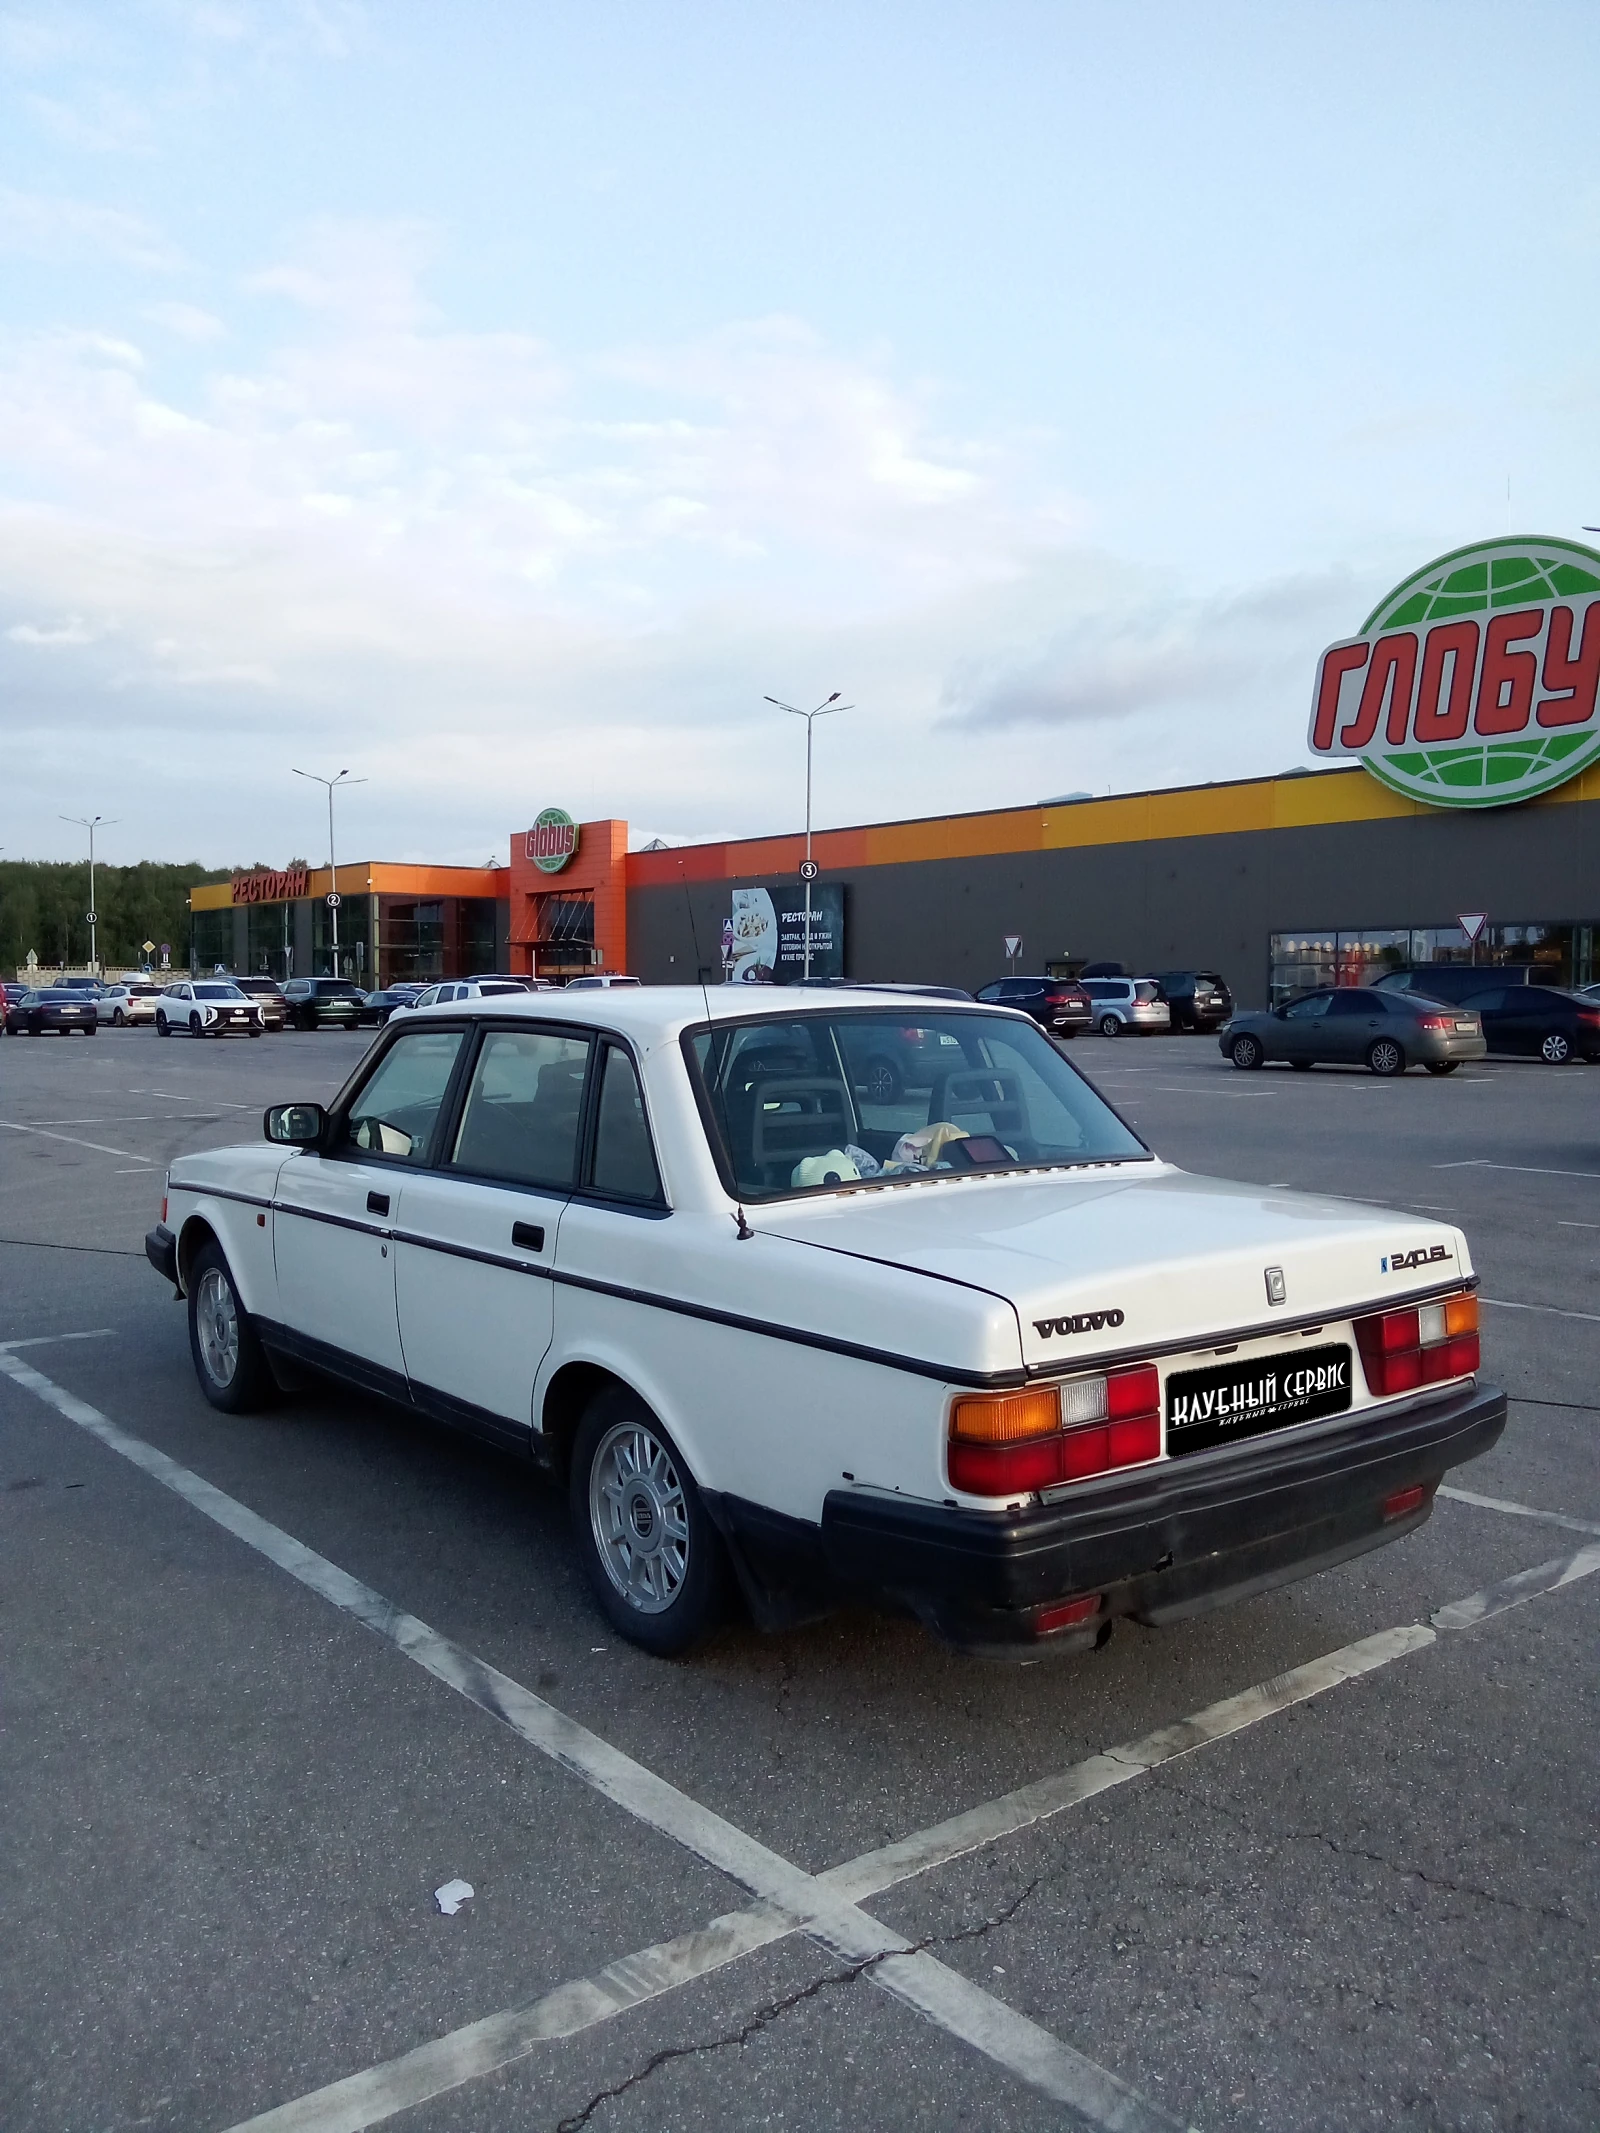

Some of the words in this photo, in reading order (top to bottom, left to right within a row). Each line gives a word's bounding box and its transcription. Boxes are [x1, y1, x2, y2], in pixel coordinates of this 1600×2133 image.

[526, 820, 575, 858] Globus
[805, 864, 813, 876] 3
[231, 869, 308, 904] РЕСТОРАН
[330, 895, 336, 905] 2
[1032, 1308, 1125, 1340] VOLVO
